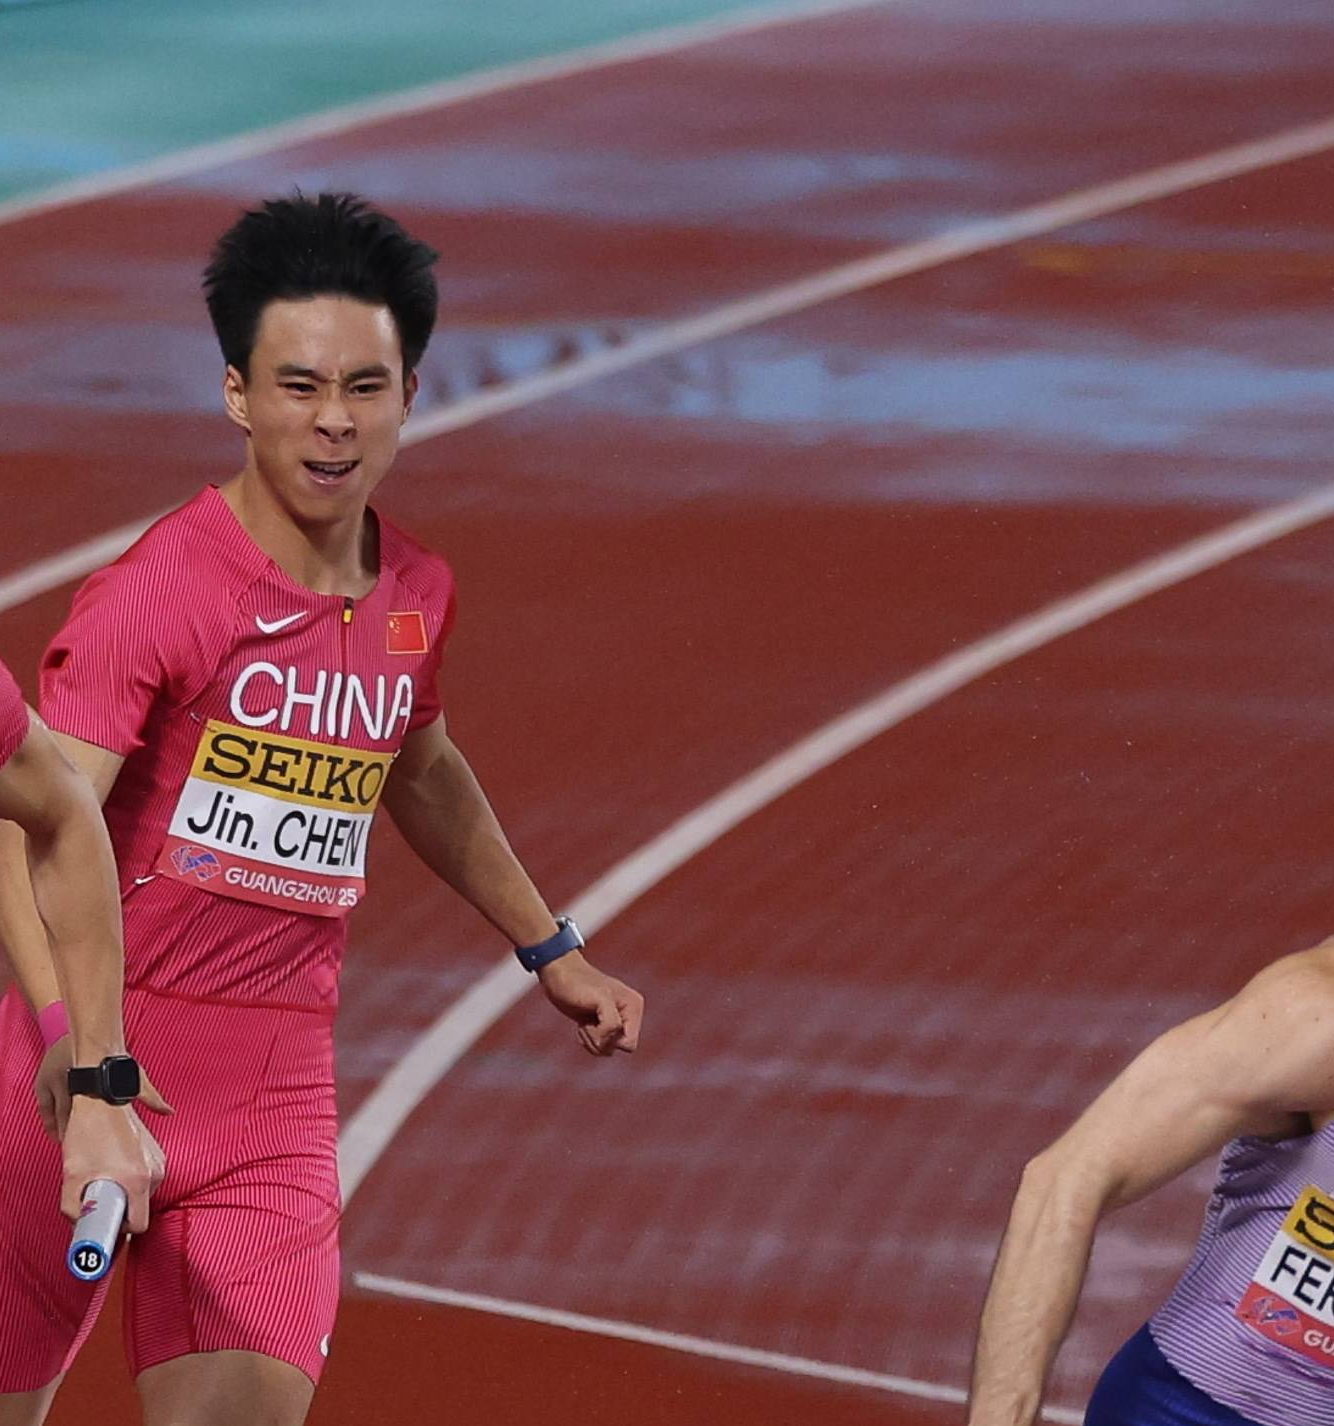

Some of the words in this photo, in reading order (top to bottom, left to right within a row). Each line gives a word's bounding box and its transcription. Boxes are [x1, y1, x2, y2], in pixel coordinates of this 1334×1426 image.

[230, 661, 413, 740] CHINA
[204, 733, 388, 806] SEIKO
[186, 791, 259, 850] Jin.
[273, 811, 365, 867] CHEN
[225, 867, 338, 906] GUANGZHOU
[338, 887, 358, 907] 25
[78, 1251, 98, 1267] 18
